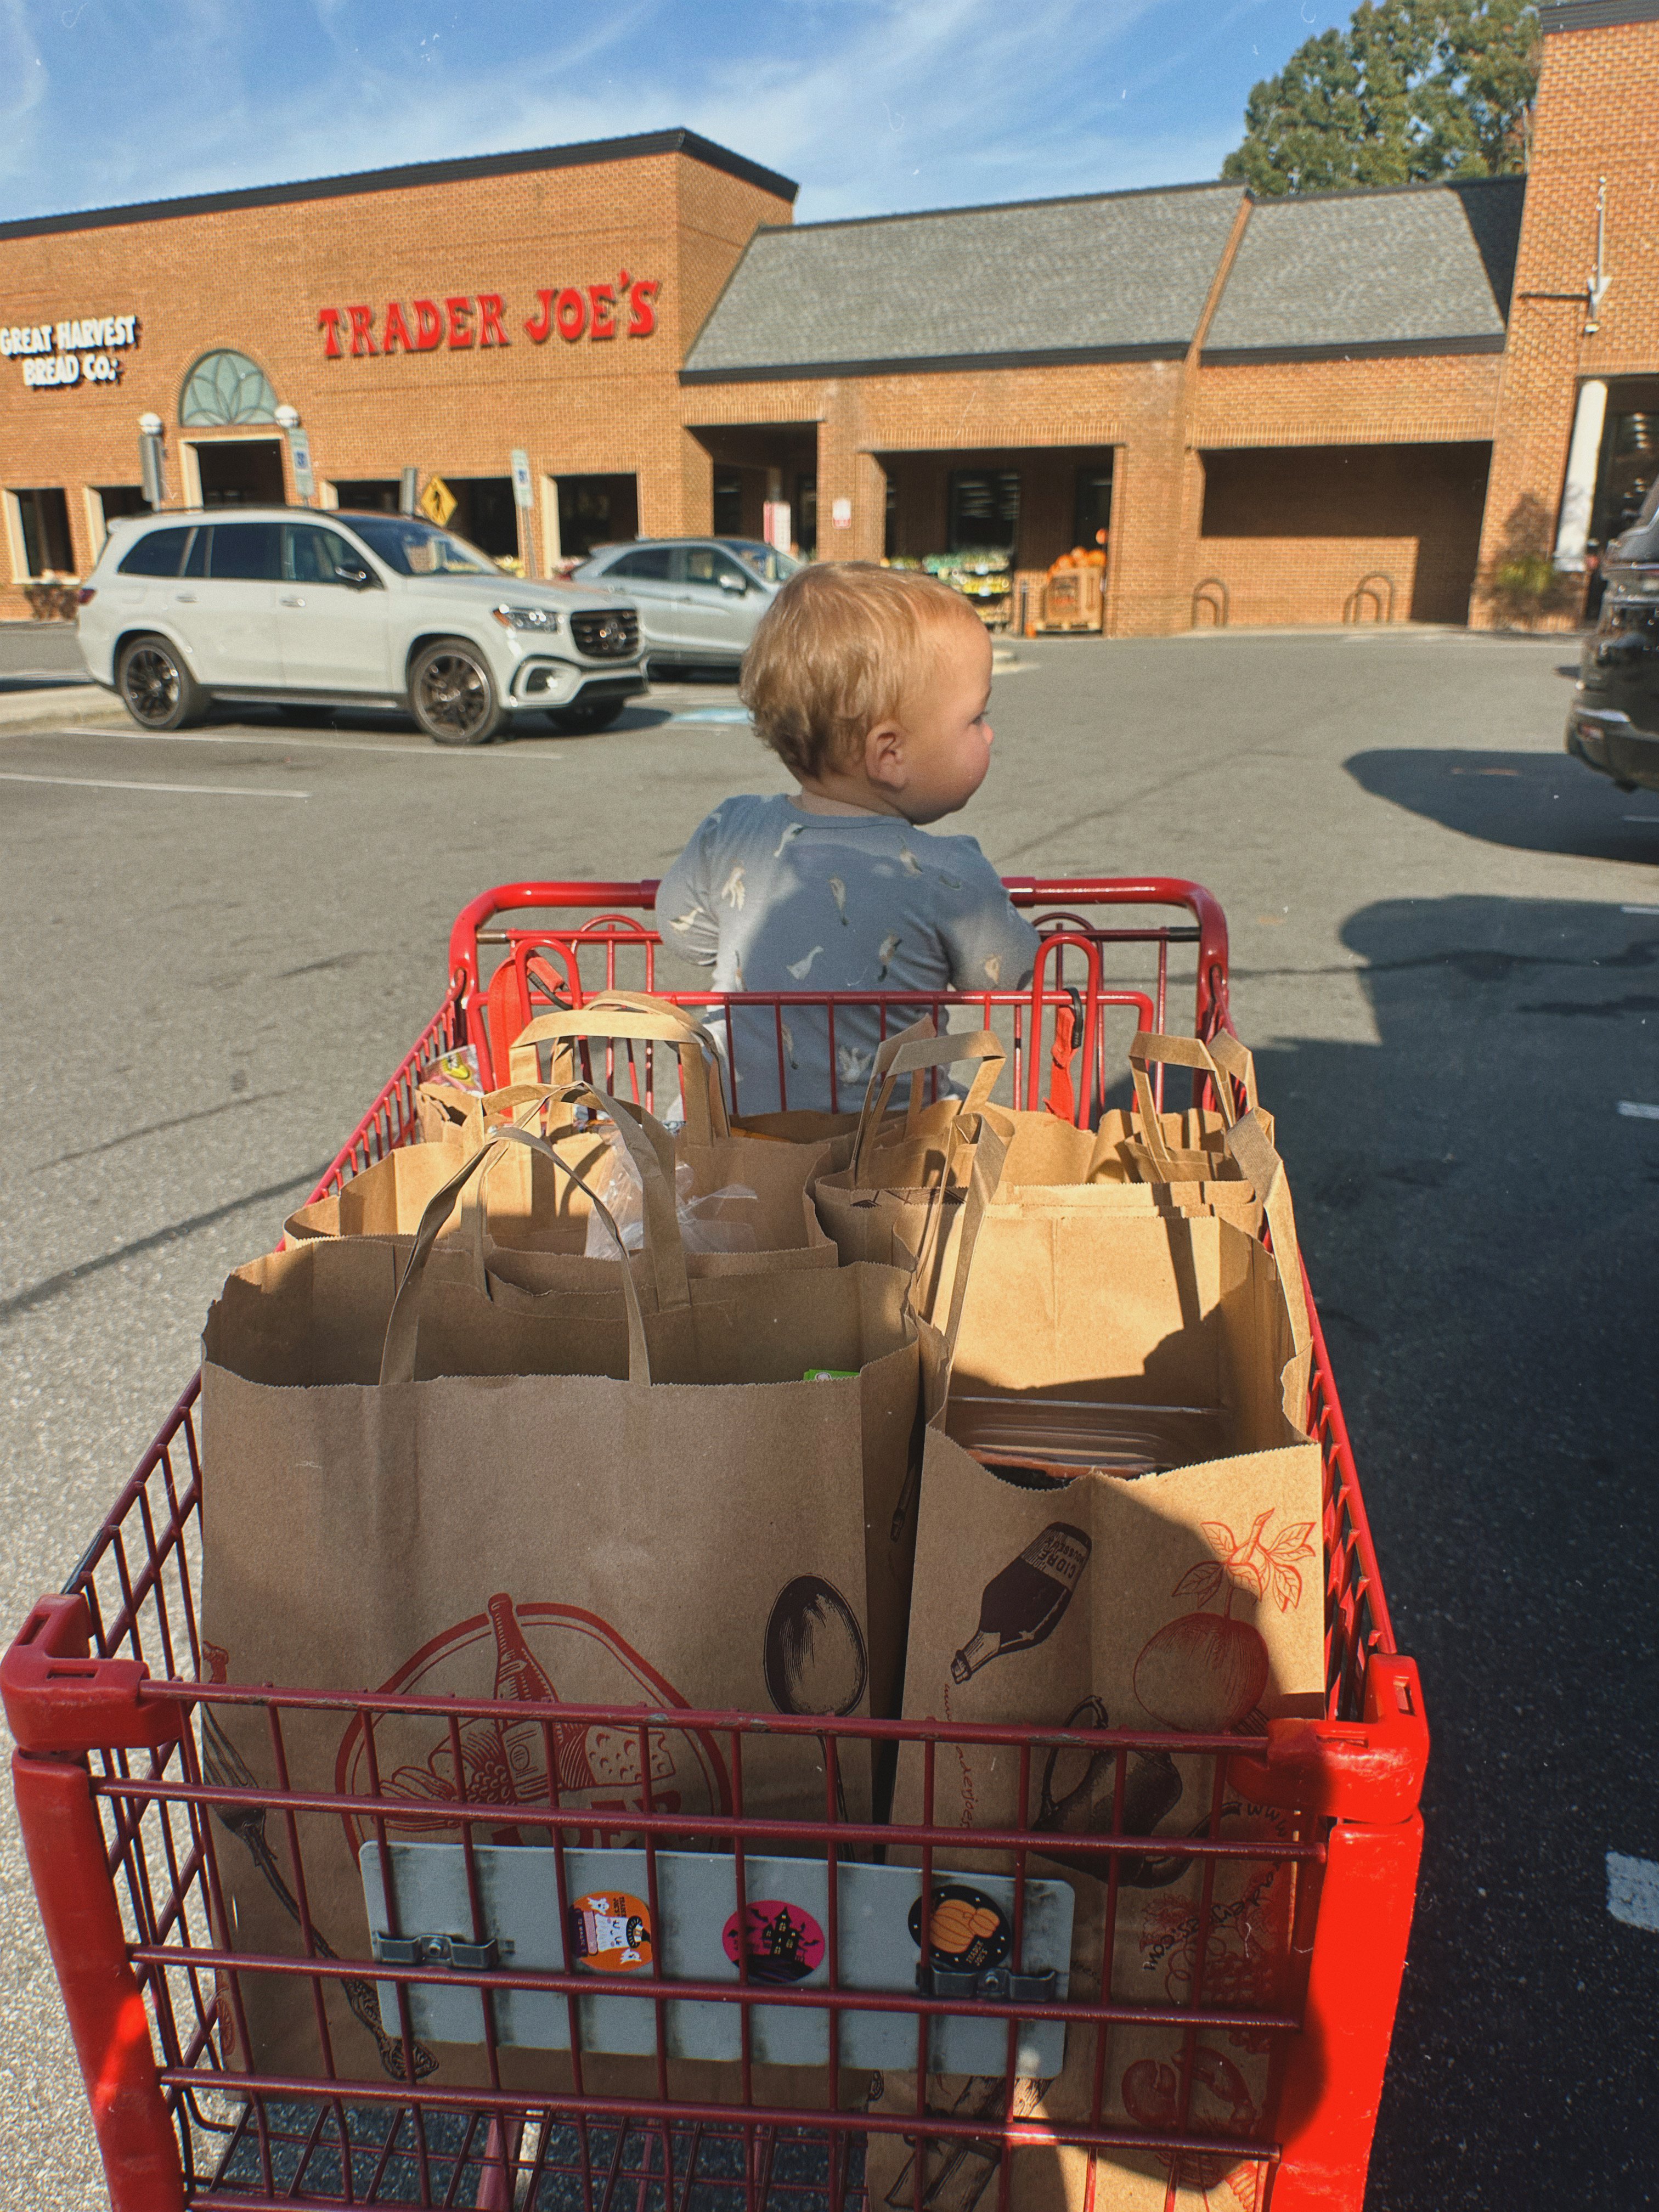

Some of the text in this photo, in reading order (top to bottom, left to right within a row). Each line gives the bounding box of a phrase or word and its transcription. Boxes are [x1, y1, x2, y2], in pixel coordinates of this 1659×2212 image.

[319, 269, 659, 357] TRADER JOE'S
[0, 315, 136, 356] GREAT HARVEST
[22, 354, 80, 386] BREAD
[1038, 1551, 1076, 1578] CIDRE
